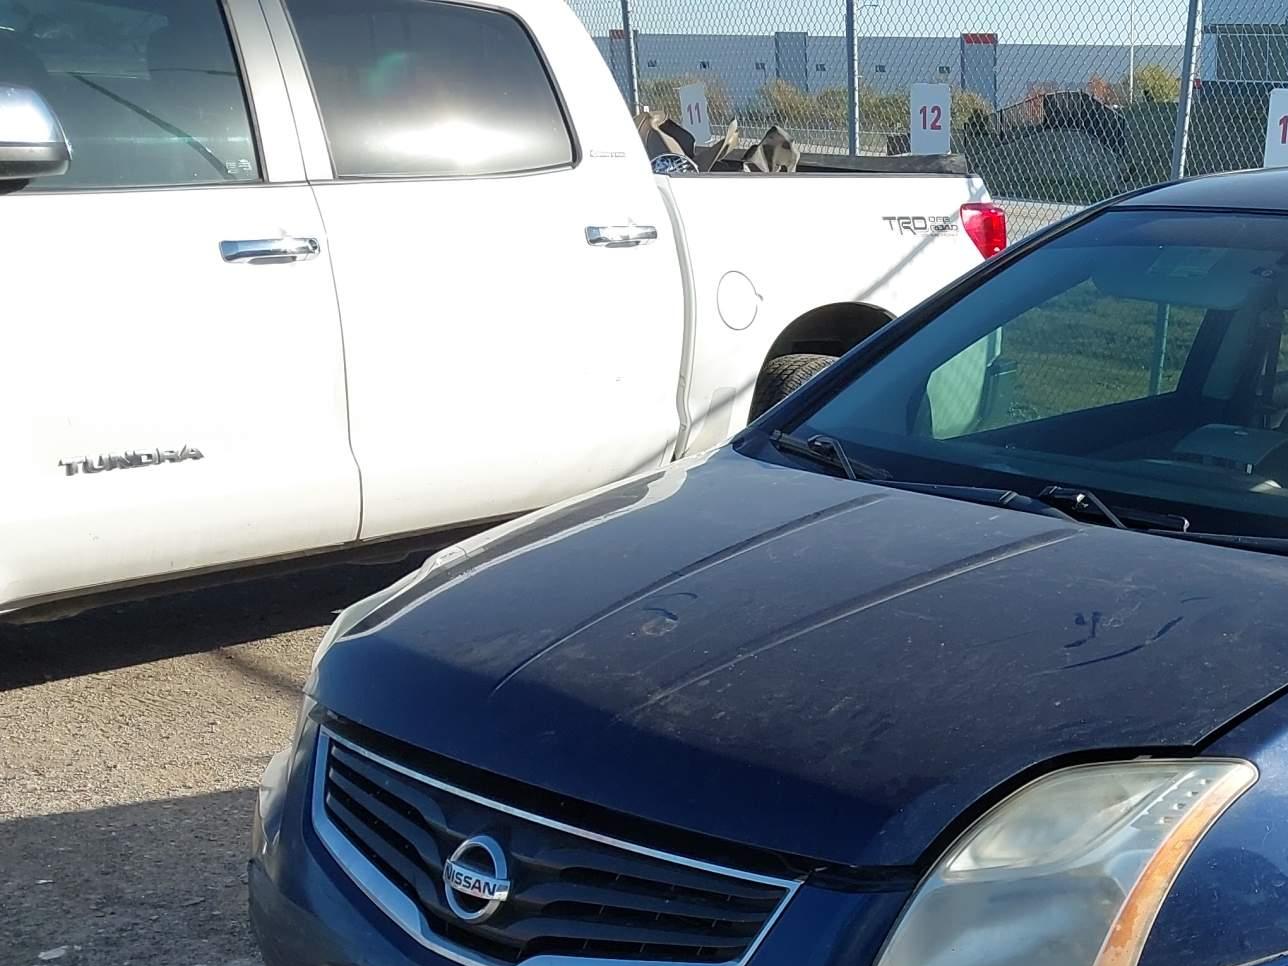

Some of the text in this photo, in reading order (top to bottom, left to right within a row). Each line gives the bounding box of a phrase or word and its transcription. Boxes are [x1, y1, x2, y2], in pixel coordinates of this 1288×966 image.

[687, 102, 701, 125] 11
[919, 105, 942, 130] 12
[882, 216, 928, 235] TRD
[58, 444, 205, 476] TUNDRA
[444, 863, 497, 897] NISSAN
